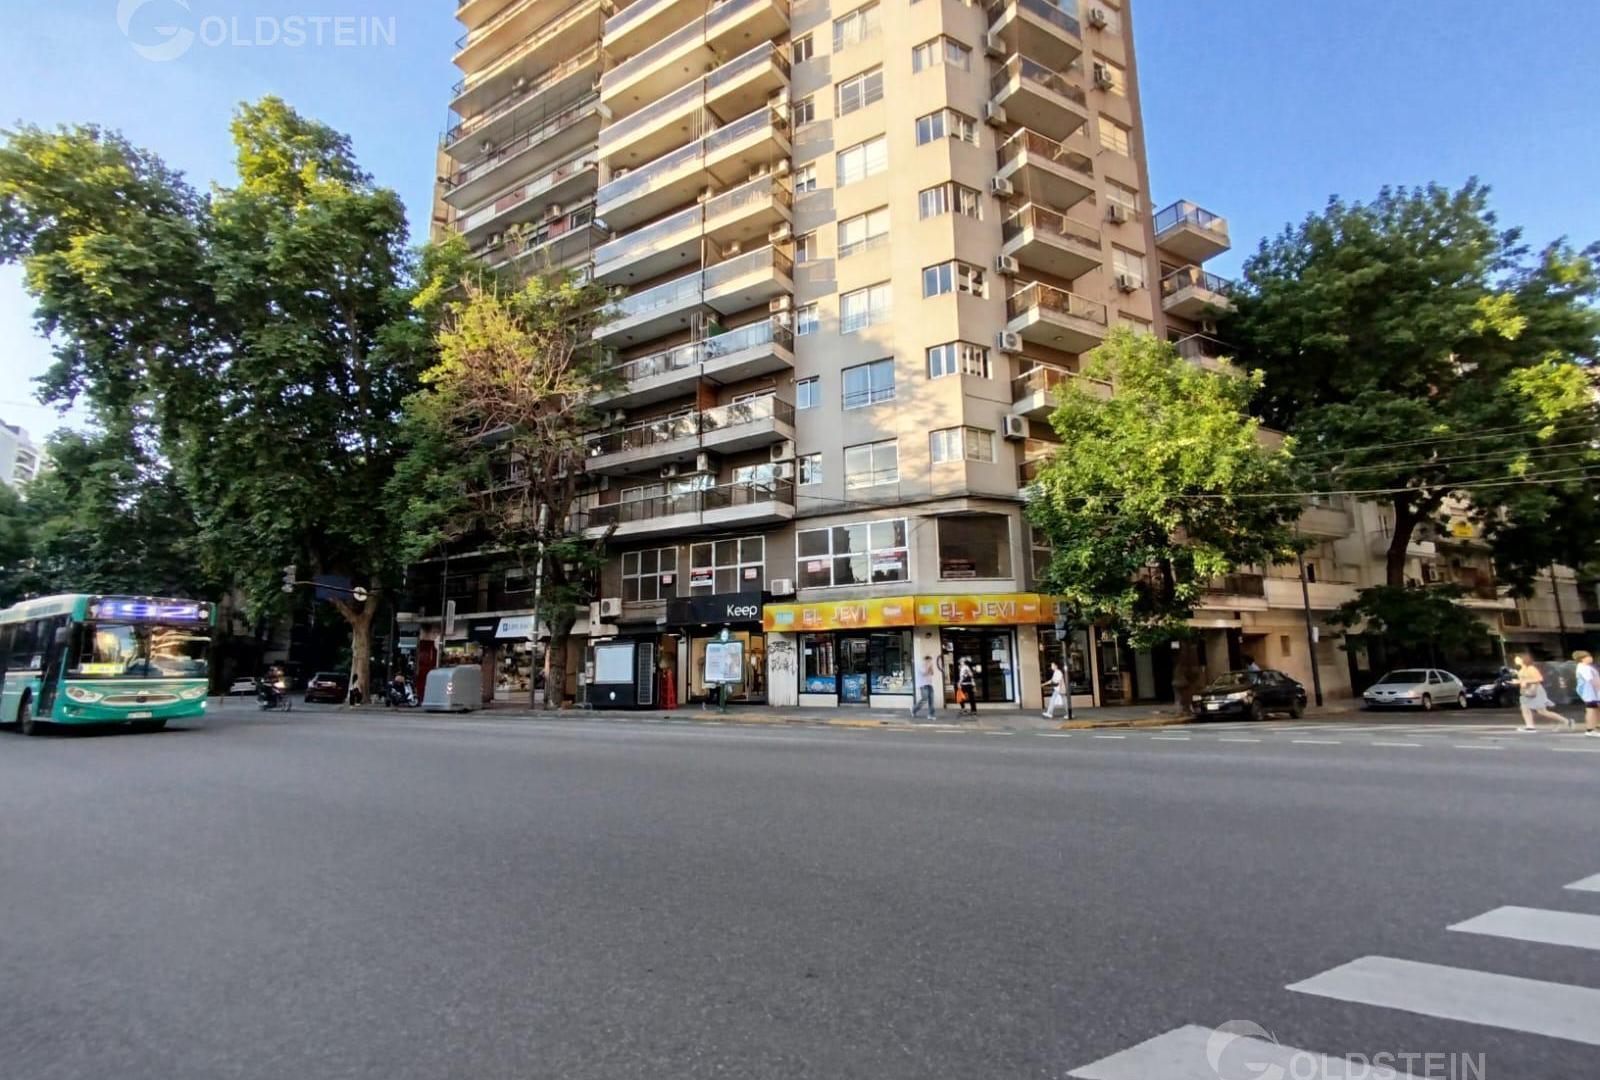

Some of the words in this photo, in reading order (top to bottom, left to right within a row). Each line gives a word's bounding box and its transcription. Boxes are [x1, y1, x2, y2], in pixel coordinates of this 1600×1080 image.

[727, 604, 758, 619] Keep
[803, 609, 823, 625] EL
[832, 605, 868, 623] JEVI
[939, 601, 963, 619] EL
[972, 600, 1018, 618] JEVI
